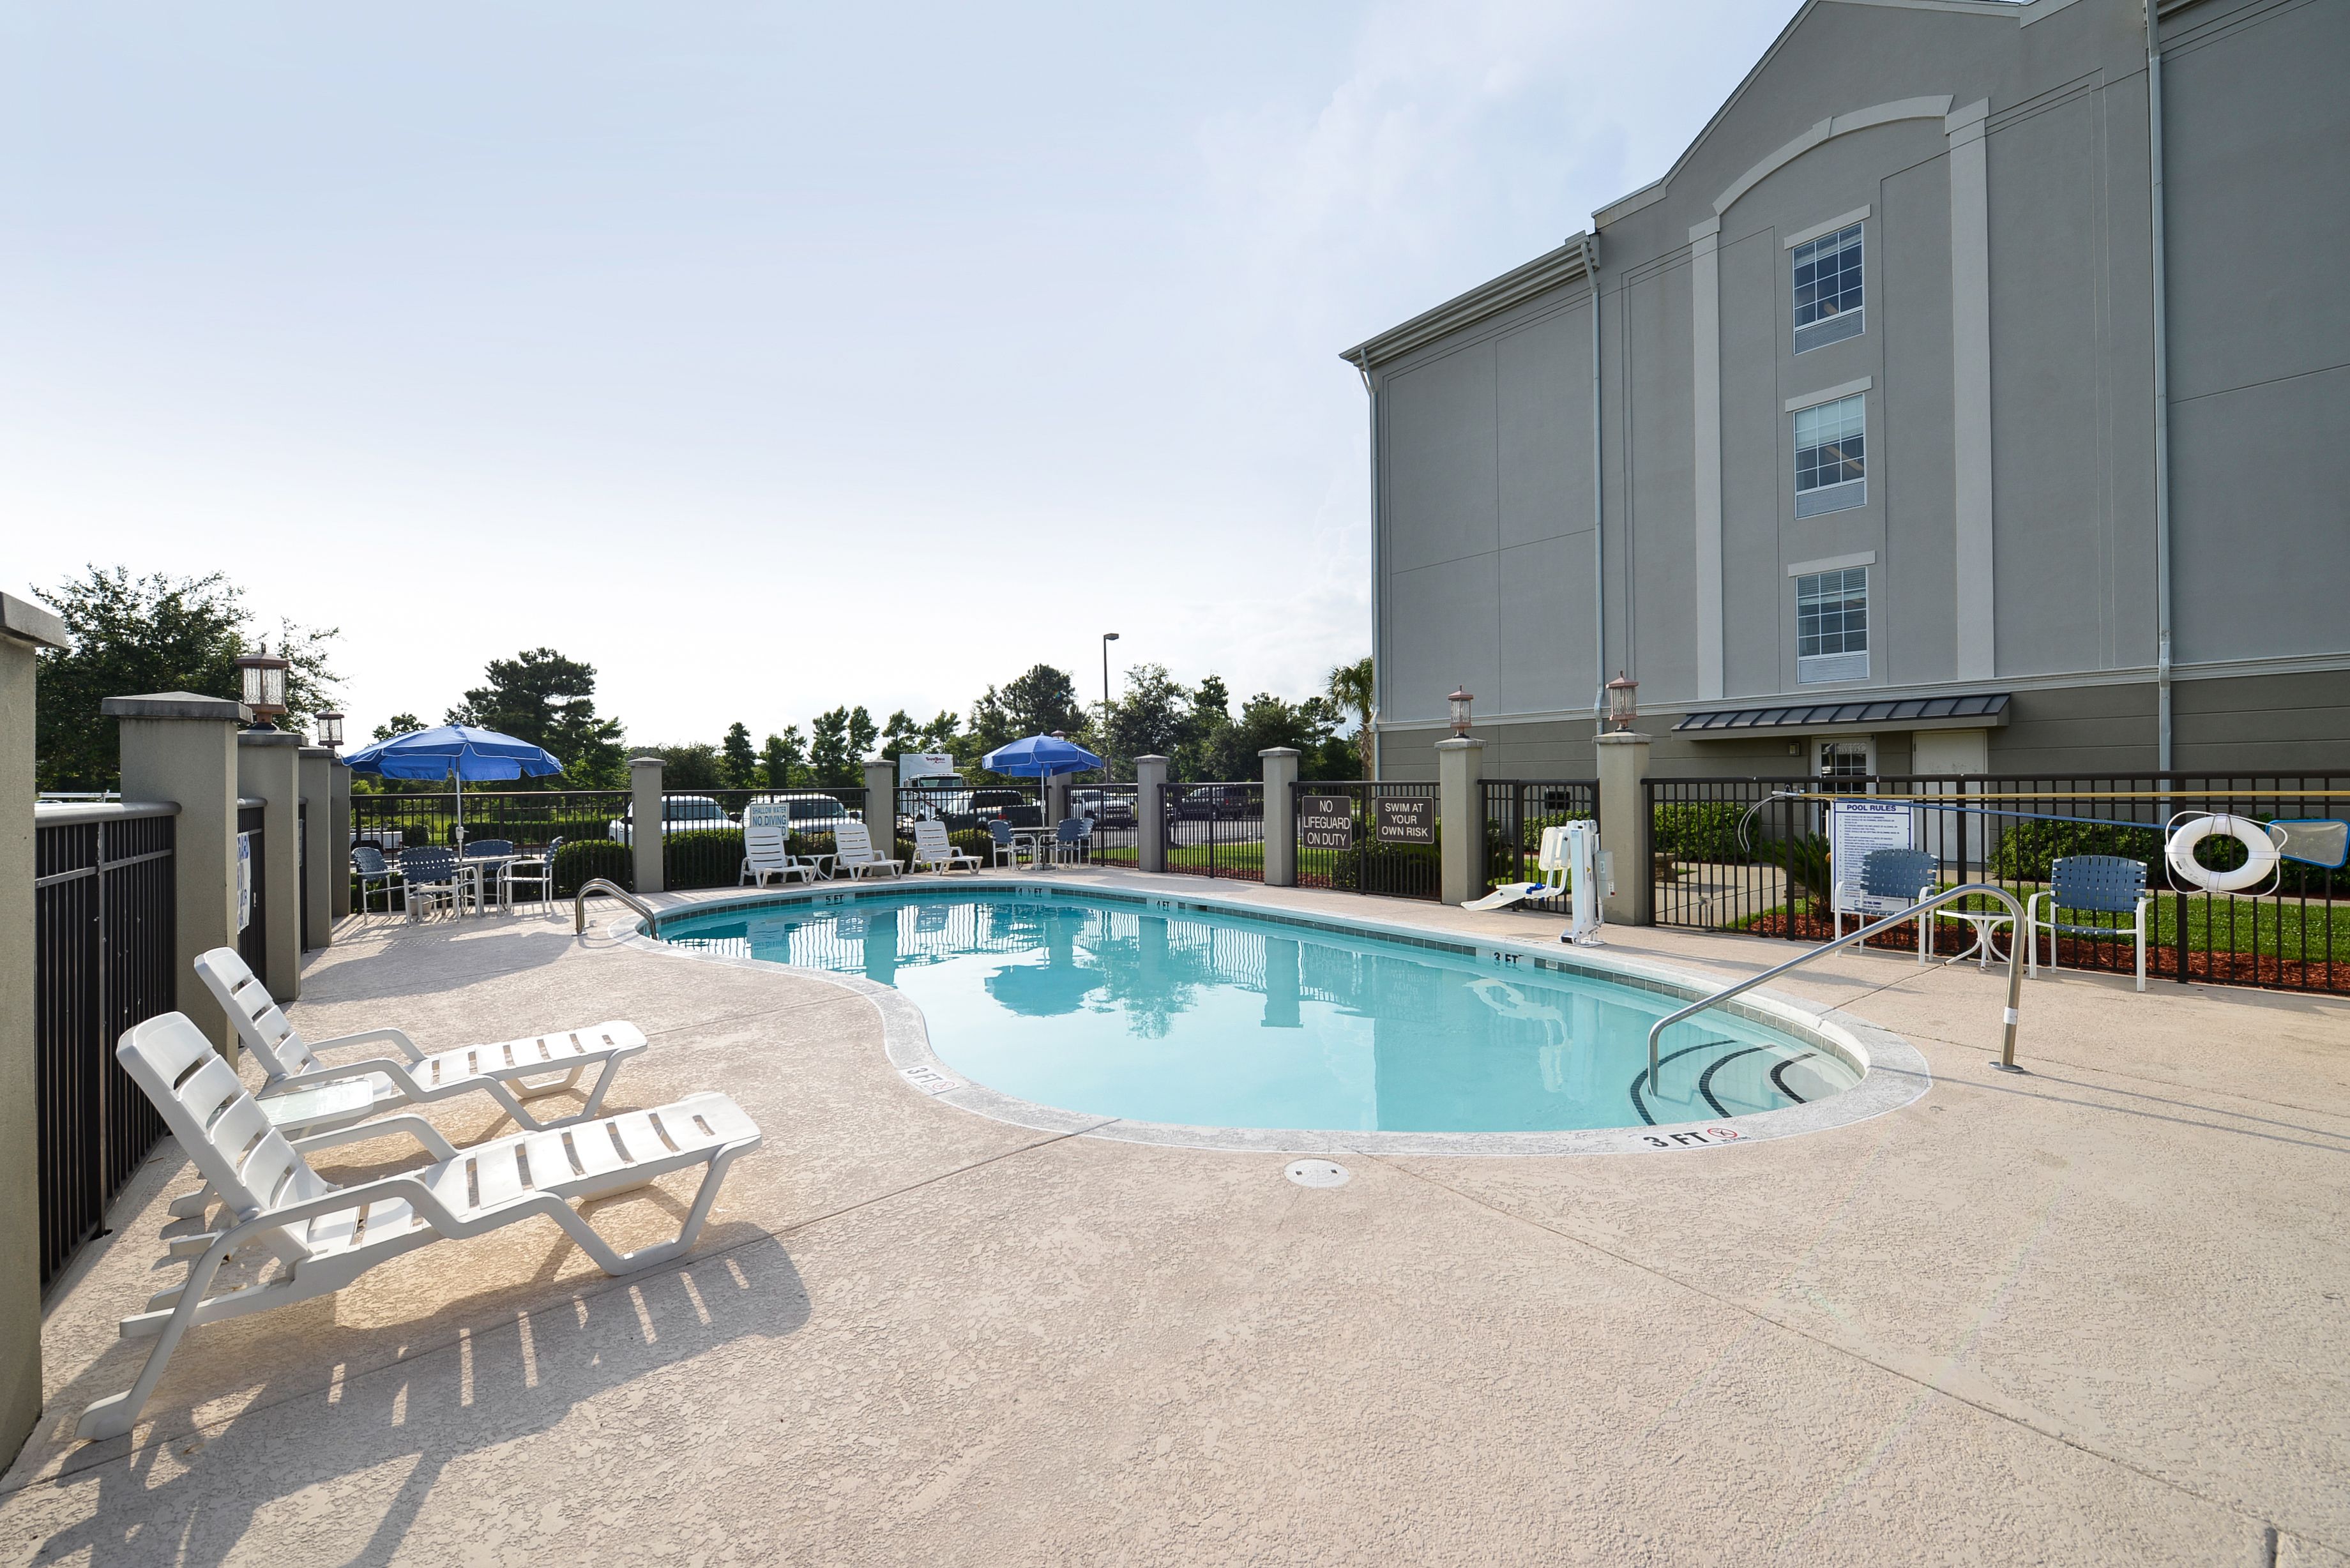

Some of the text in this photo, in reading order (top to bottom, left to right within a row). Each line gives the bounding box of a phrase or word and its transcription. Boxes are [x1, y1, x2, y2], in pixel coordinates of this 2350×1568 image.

[1319, 800, 1333, 813] NO
[1384, 803, 1424, 813] SWIM AT
[752, 815, 787, 826] NO DIVING
[1303, 816, 1351, 829] LIFEGUARD
[1391, 815, 1417, 824] YOUR
[1381, 825, 1429, 837] OWN RISK
[1307, 832, 1347, 846] ON DUTY
[1505, 953, 1519, 964] FT
[914, 1073, 943, 1083] FT
[1643, 1131, 1710, 1147] 3 FT
